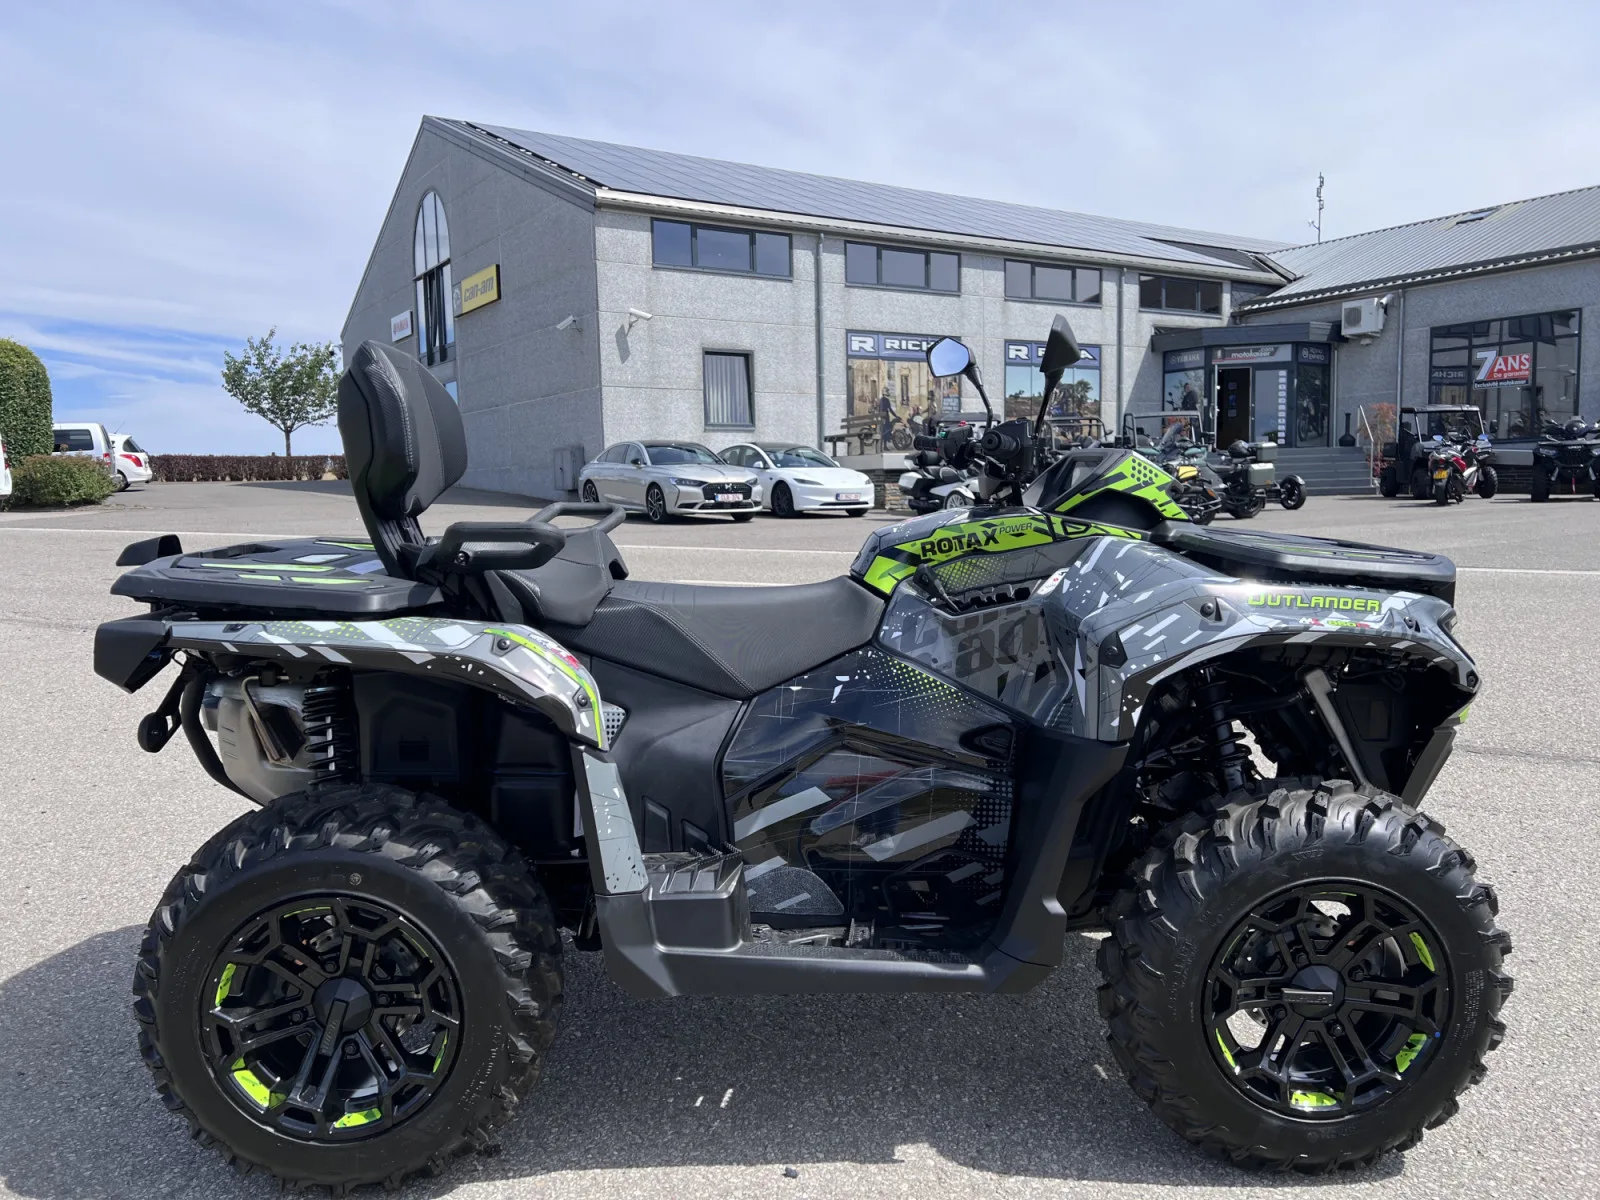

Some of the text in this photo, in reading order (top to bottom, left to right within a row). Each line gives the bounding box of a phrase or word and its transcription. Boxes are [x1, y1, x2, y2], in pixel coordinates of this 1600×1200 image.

[463, 276, 494, 303] can-am
[1476, 350, 1530, 380] 7 ANS
[921, 522, 1033, 557] ROTAX POWER
[1247, 592, 1381, 613] OUTLANDER
